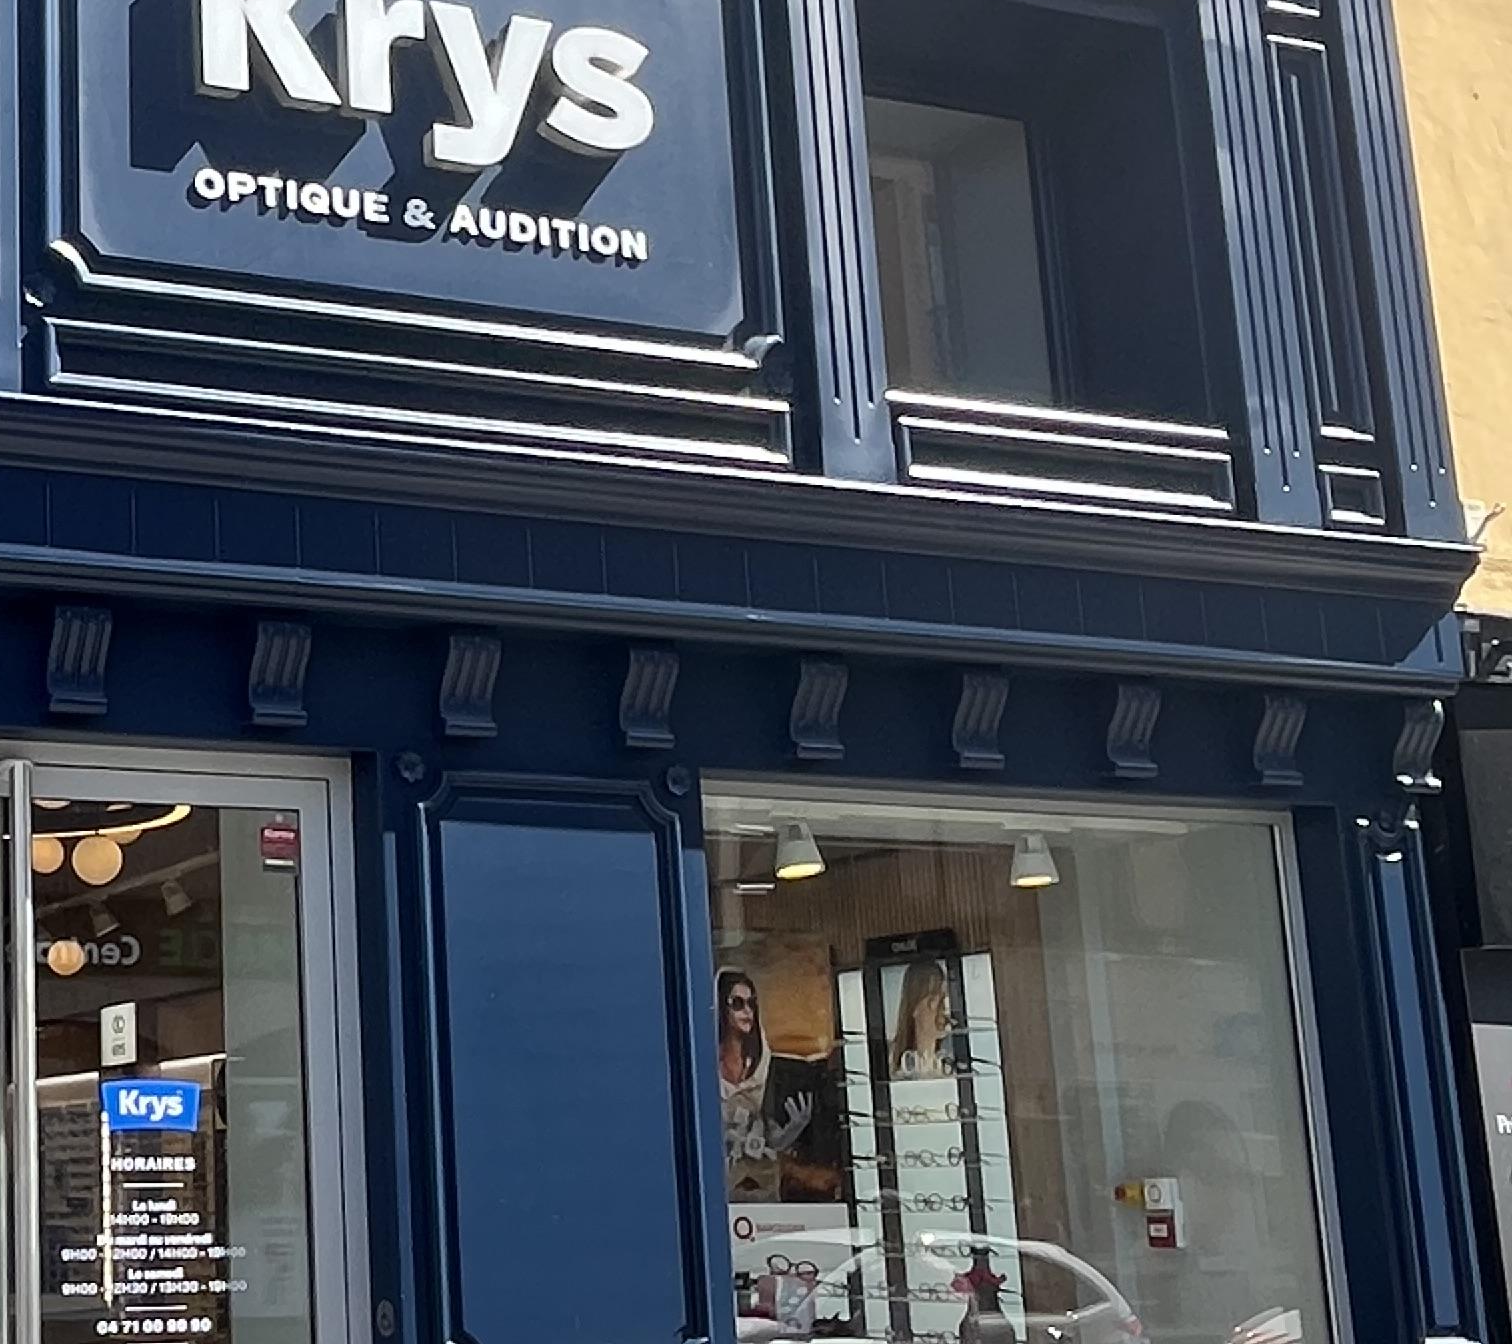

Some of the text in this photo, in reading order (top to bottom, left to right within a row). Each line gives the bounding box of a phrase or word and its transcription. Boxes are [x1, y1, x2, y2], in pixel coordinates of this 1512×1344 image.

[193, 167, 649, 261] OPTIQUE & AUDITION
[118, 1088, 184, 1121] Krys
[111, 1157, 196, 1172] HORAIRES
[96, 1320, 119, 1336] 04
[121, 1320, 140, 1335] 71
